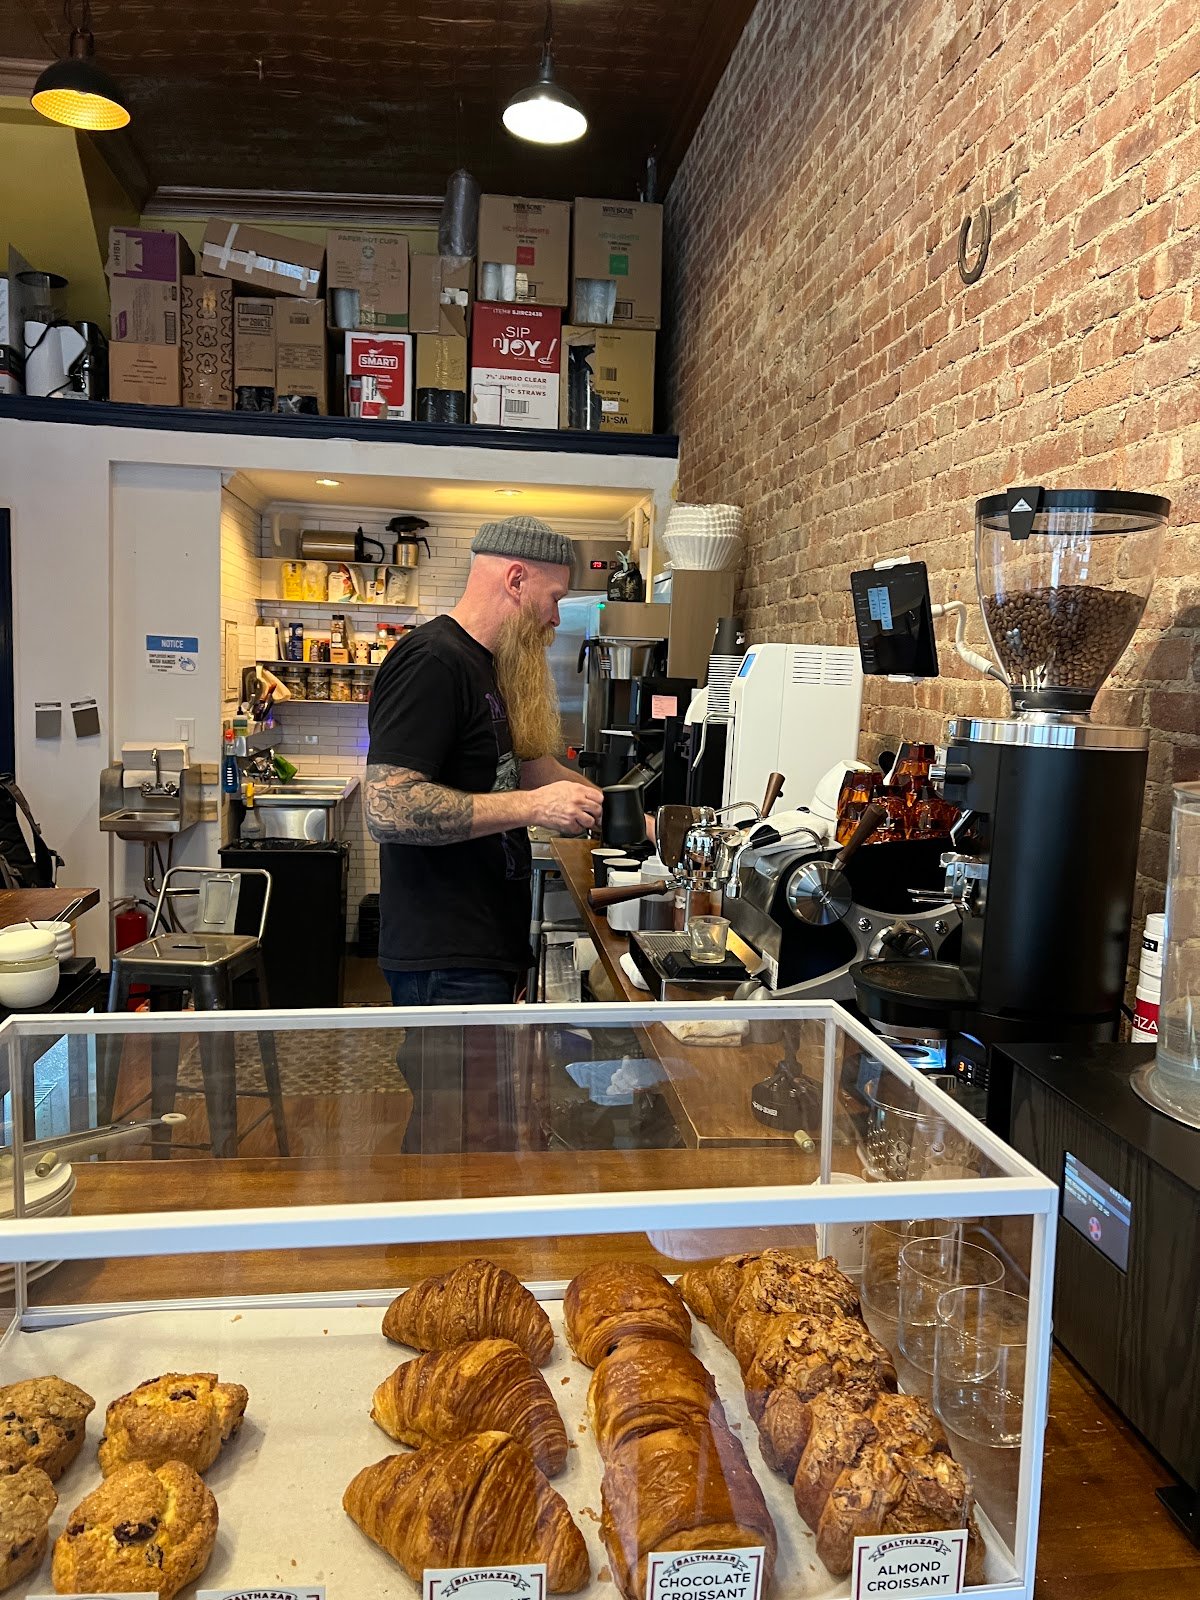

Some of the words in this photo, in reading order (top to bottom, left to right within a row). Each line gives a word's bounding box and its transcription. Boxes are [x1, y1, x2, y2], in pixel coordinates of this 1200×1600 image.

[505, 326, 531, 338] SIP
[361, 356, 396, 366] SMART
[524, 376, 547, 384] CLEAR
[517, 389, 547, 397] STRAWS
[161, 639, 184, 649] NOTICE
[881, 1538, 939, 1551] BALTHAZAR
[676, 1554, 736, 1566] BALTHAZAR
[877, 1561, 941, 1576] ALMOND
[454, 1572, 517, 1585] BALTHAZAR
[659, 1572, 751, 1588] CHOCOLATE
[867, 1574, 950, 1592] CROISSANT
[661, 1587, 747, 1600] CROISSANT
